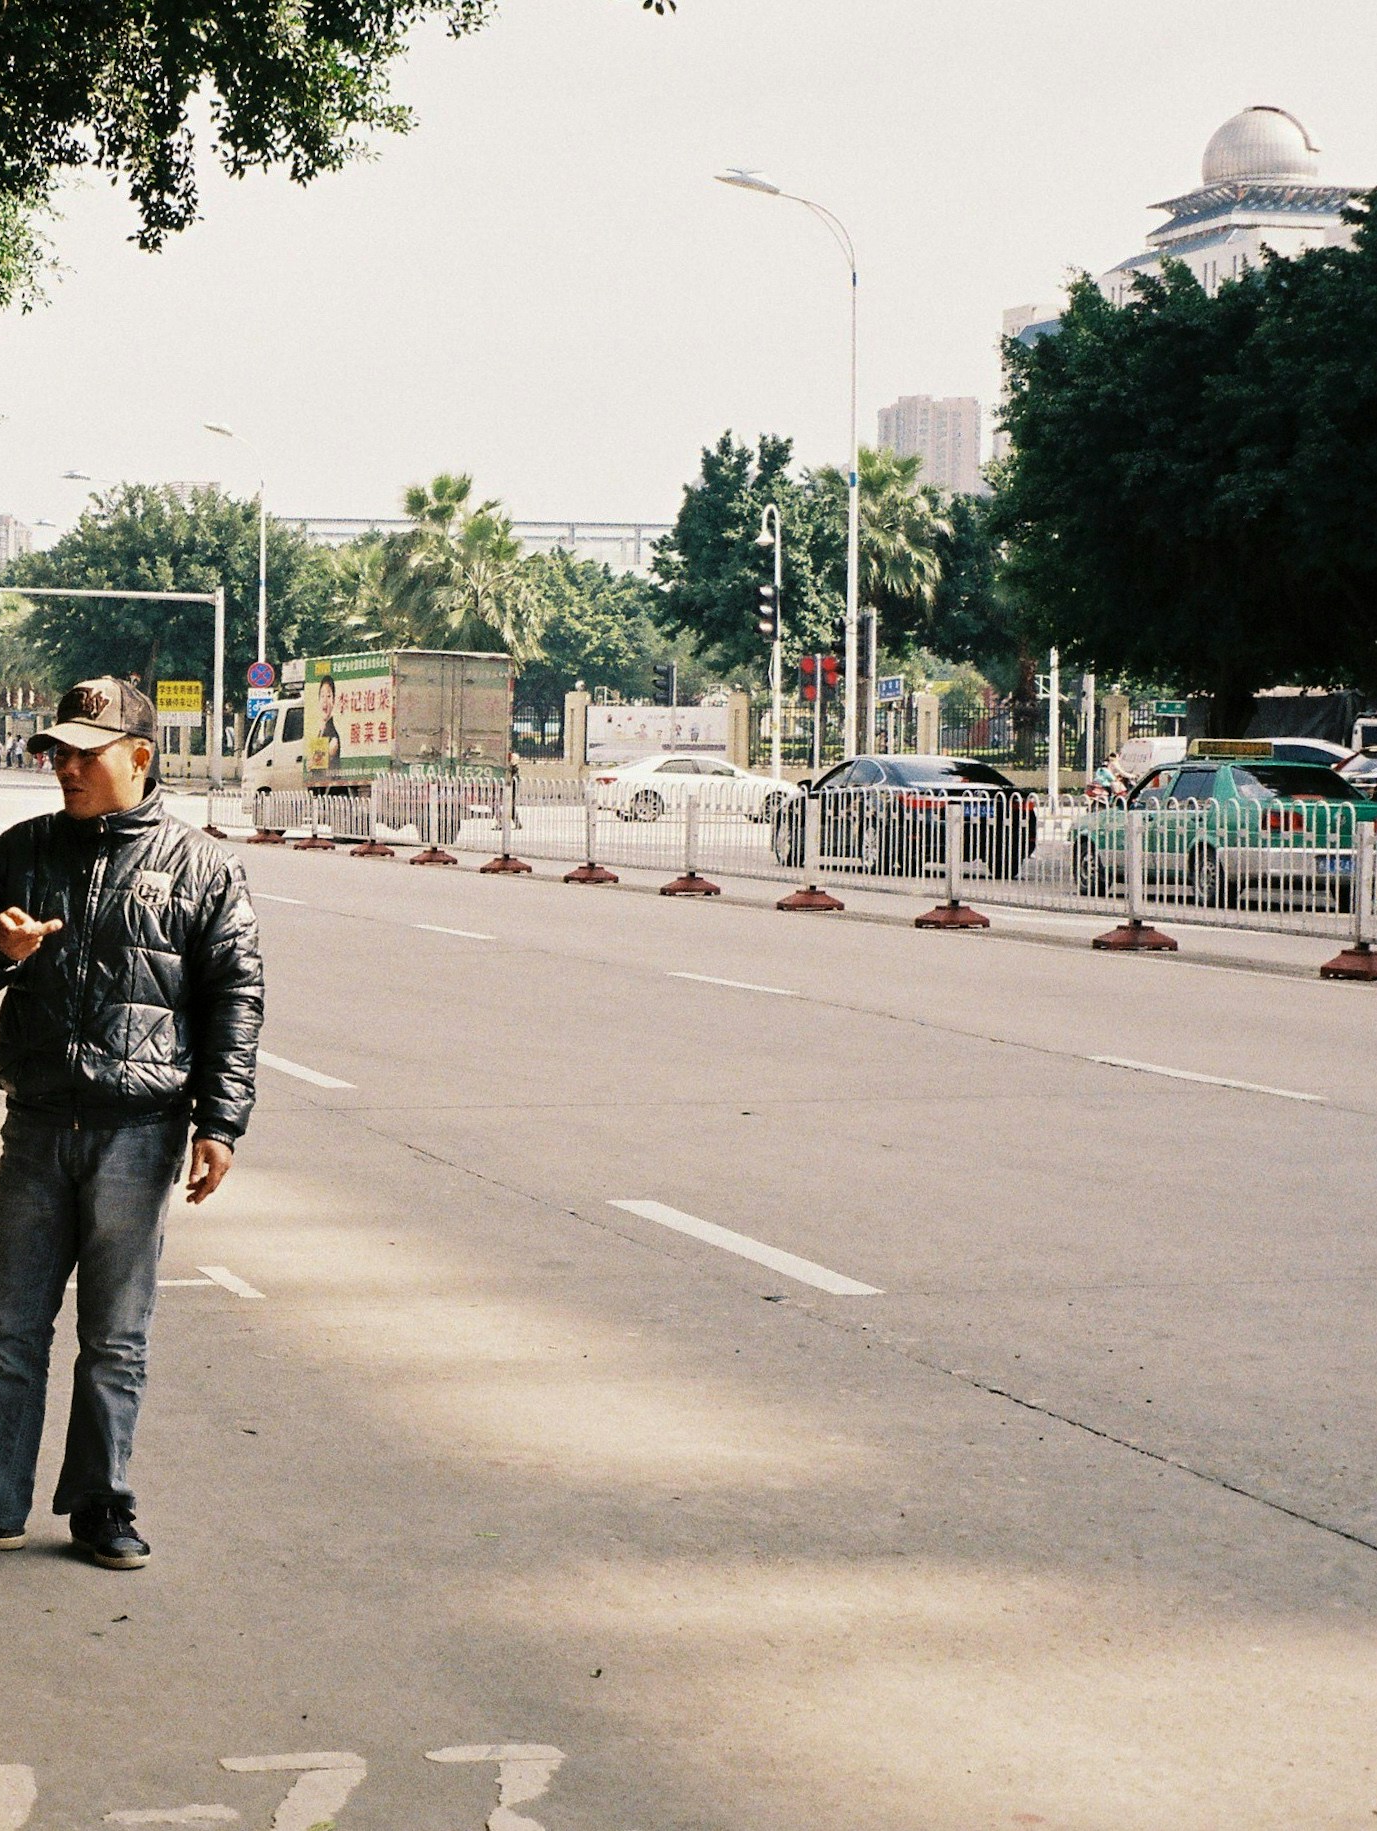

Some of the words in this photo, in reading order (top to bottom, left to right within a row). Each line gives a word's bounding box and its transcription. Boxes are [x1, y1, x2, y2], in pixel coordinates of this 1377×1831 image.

[338, 687, 389, 714] 李记泡菜
[350, 721, 389, 744] 酸菜鱼
